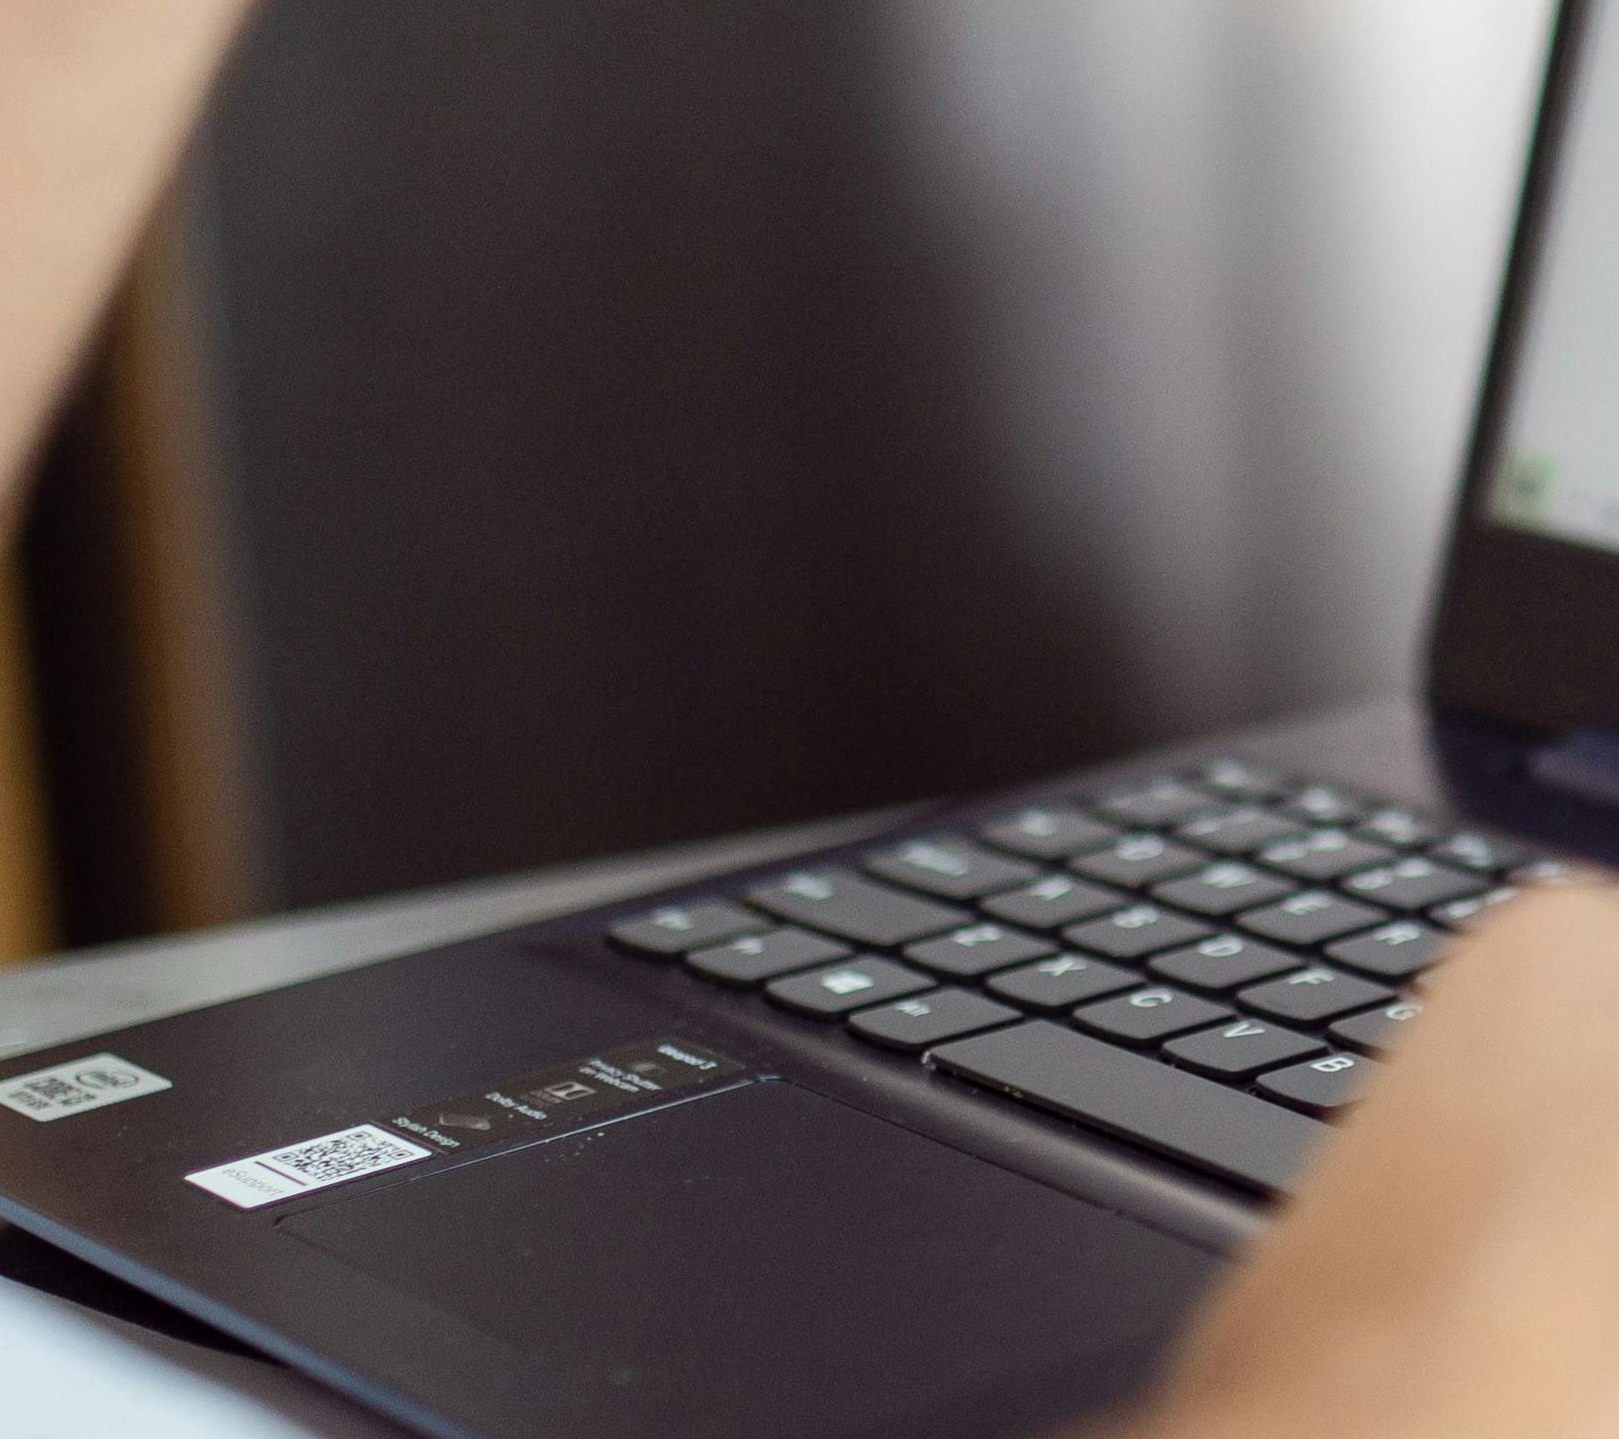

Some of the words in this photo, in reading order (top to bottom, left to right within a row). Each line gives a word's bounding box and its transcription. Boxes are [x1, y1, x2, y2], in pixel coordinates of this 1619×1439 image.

[1198, 934, 1245, 957] D
[1037, 954, 1087, 978] X
[1288, 967, 1335, 986] F
[1129, 987, 1174, 1009] C
[1222, 1020, 1266, 1039] V
[1309, 1051, 1356, 1073] B
[221, 1166, 284, 1198] eSupport
